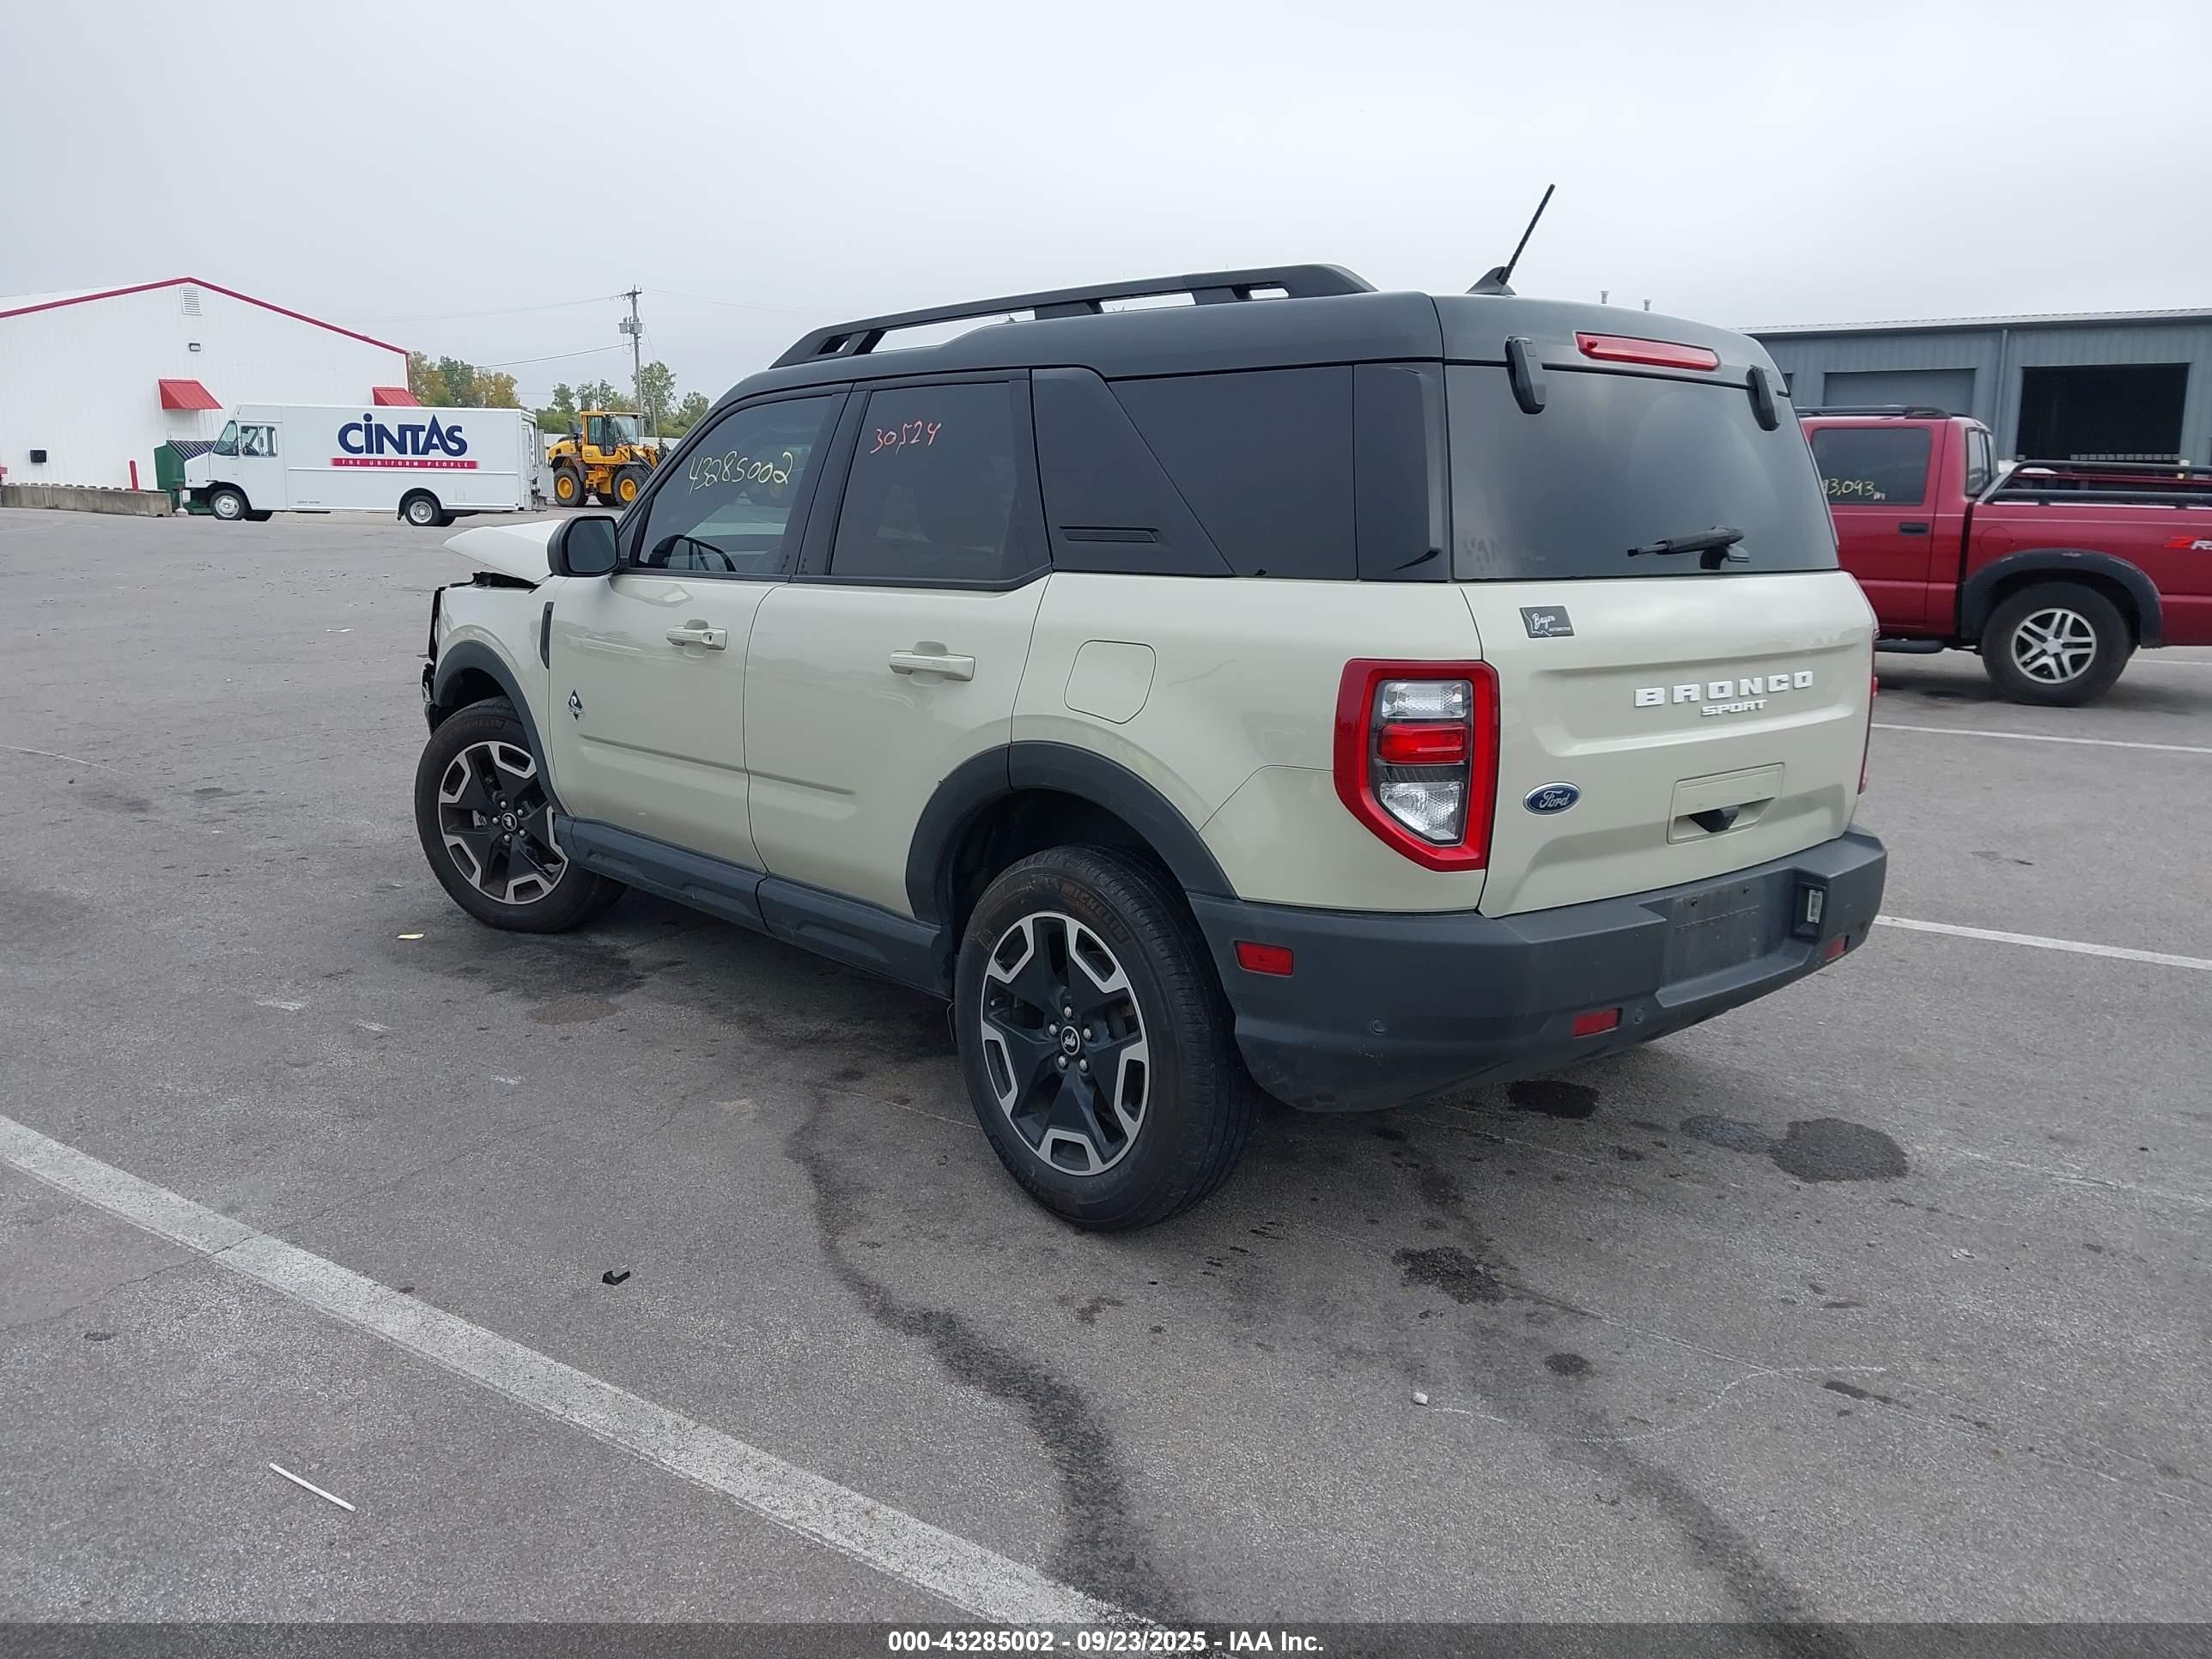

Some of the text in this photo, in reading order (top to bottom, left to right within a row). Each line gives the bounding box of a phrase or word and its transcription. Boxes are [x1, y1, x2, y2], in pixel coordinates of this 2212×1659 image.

[689, 450, 793, 495] 43285002
[1635, 671, 1813, 707] BRONCO
[1701, 700, 1767, 716] SPORT
[1540, 790, 1571, 808] Ford
[1060, 882, 1133, 945] MICHELIN
